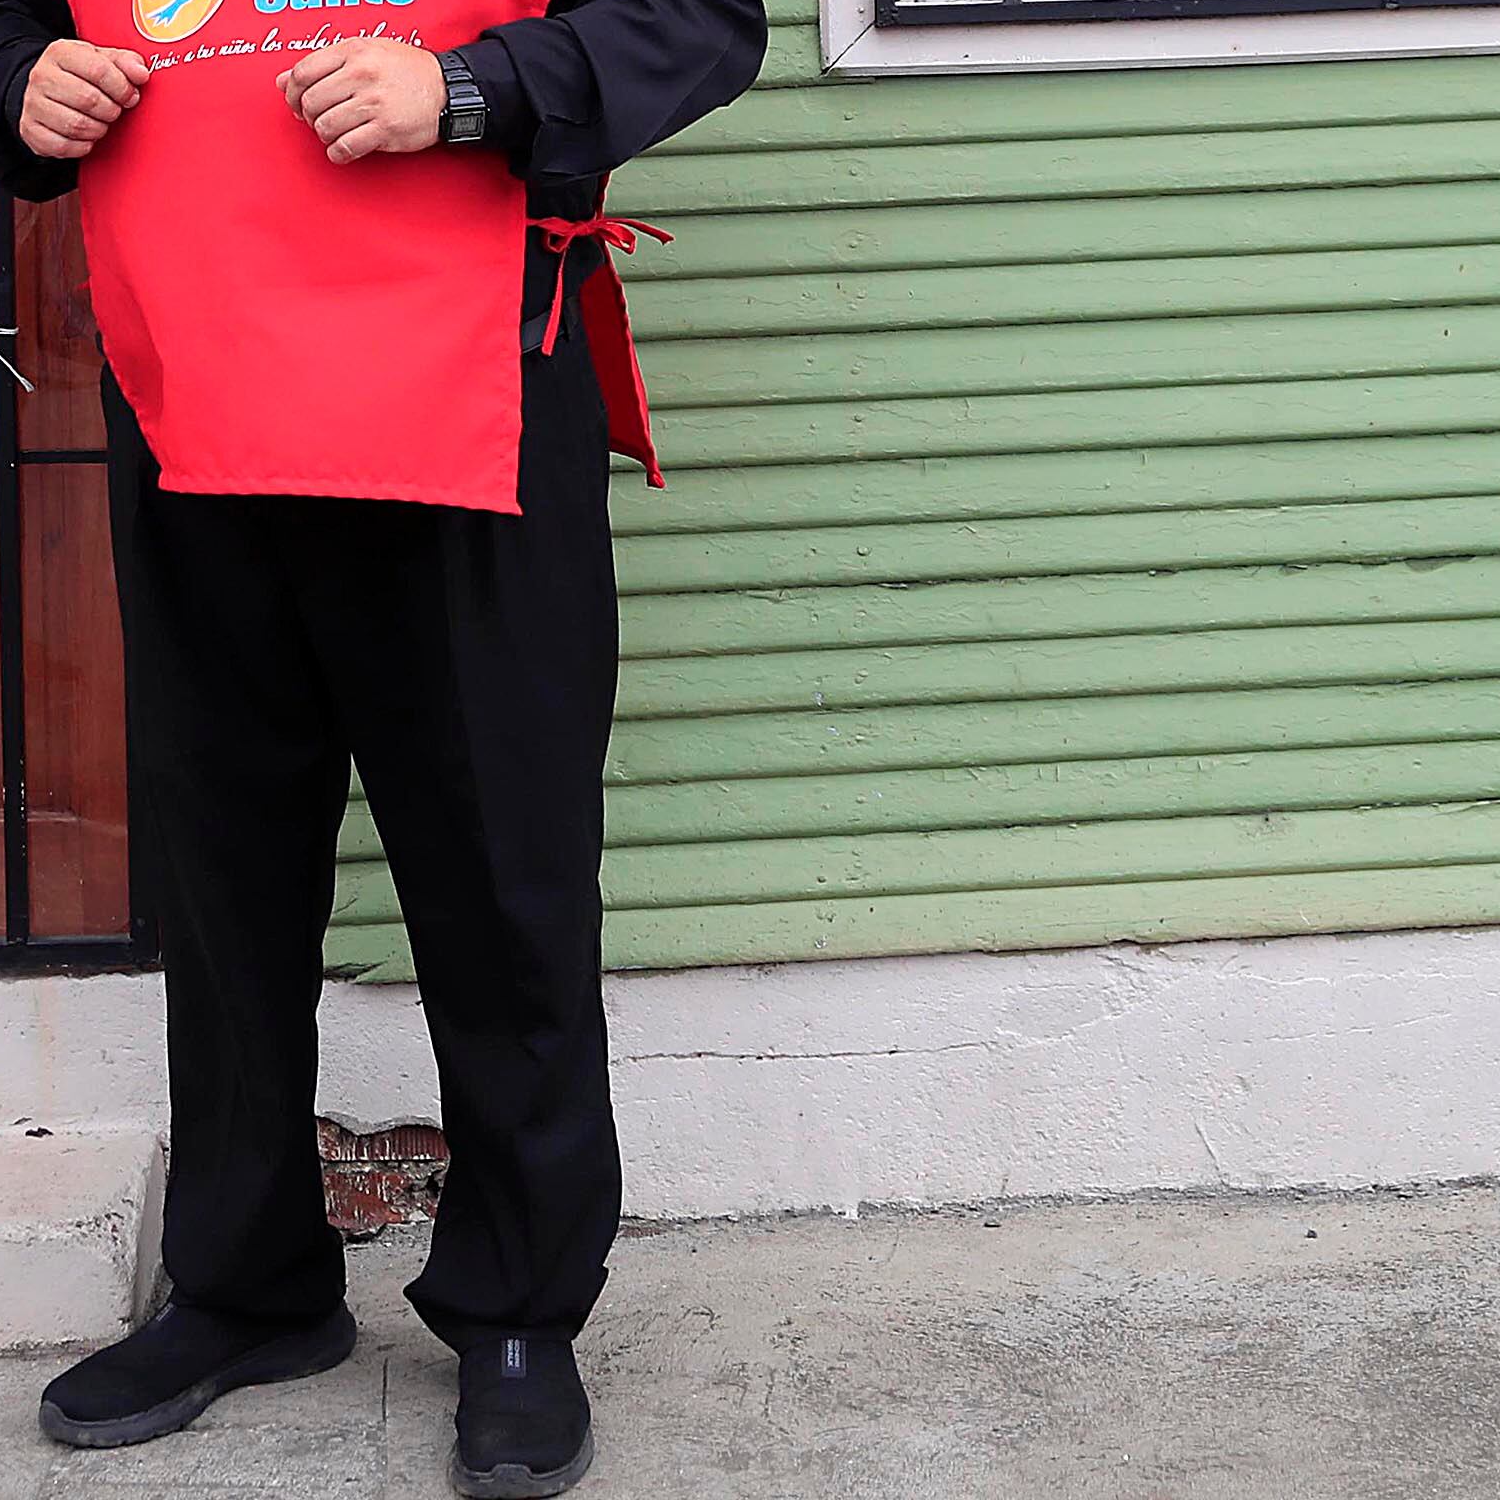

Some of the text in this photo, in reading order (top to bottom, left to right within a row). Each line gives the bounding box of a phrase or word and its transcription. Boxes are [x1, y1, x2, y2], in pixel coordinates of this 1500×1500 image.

[183, 50, 196, 63] a
[218, 39, 257, 56] niños
[261, 27, 283, 52] los
